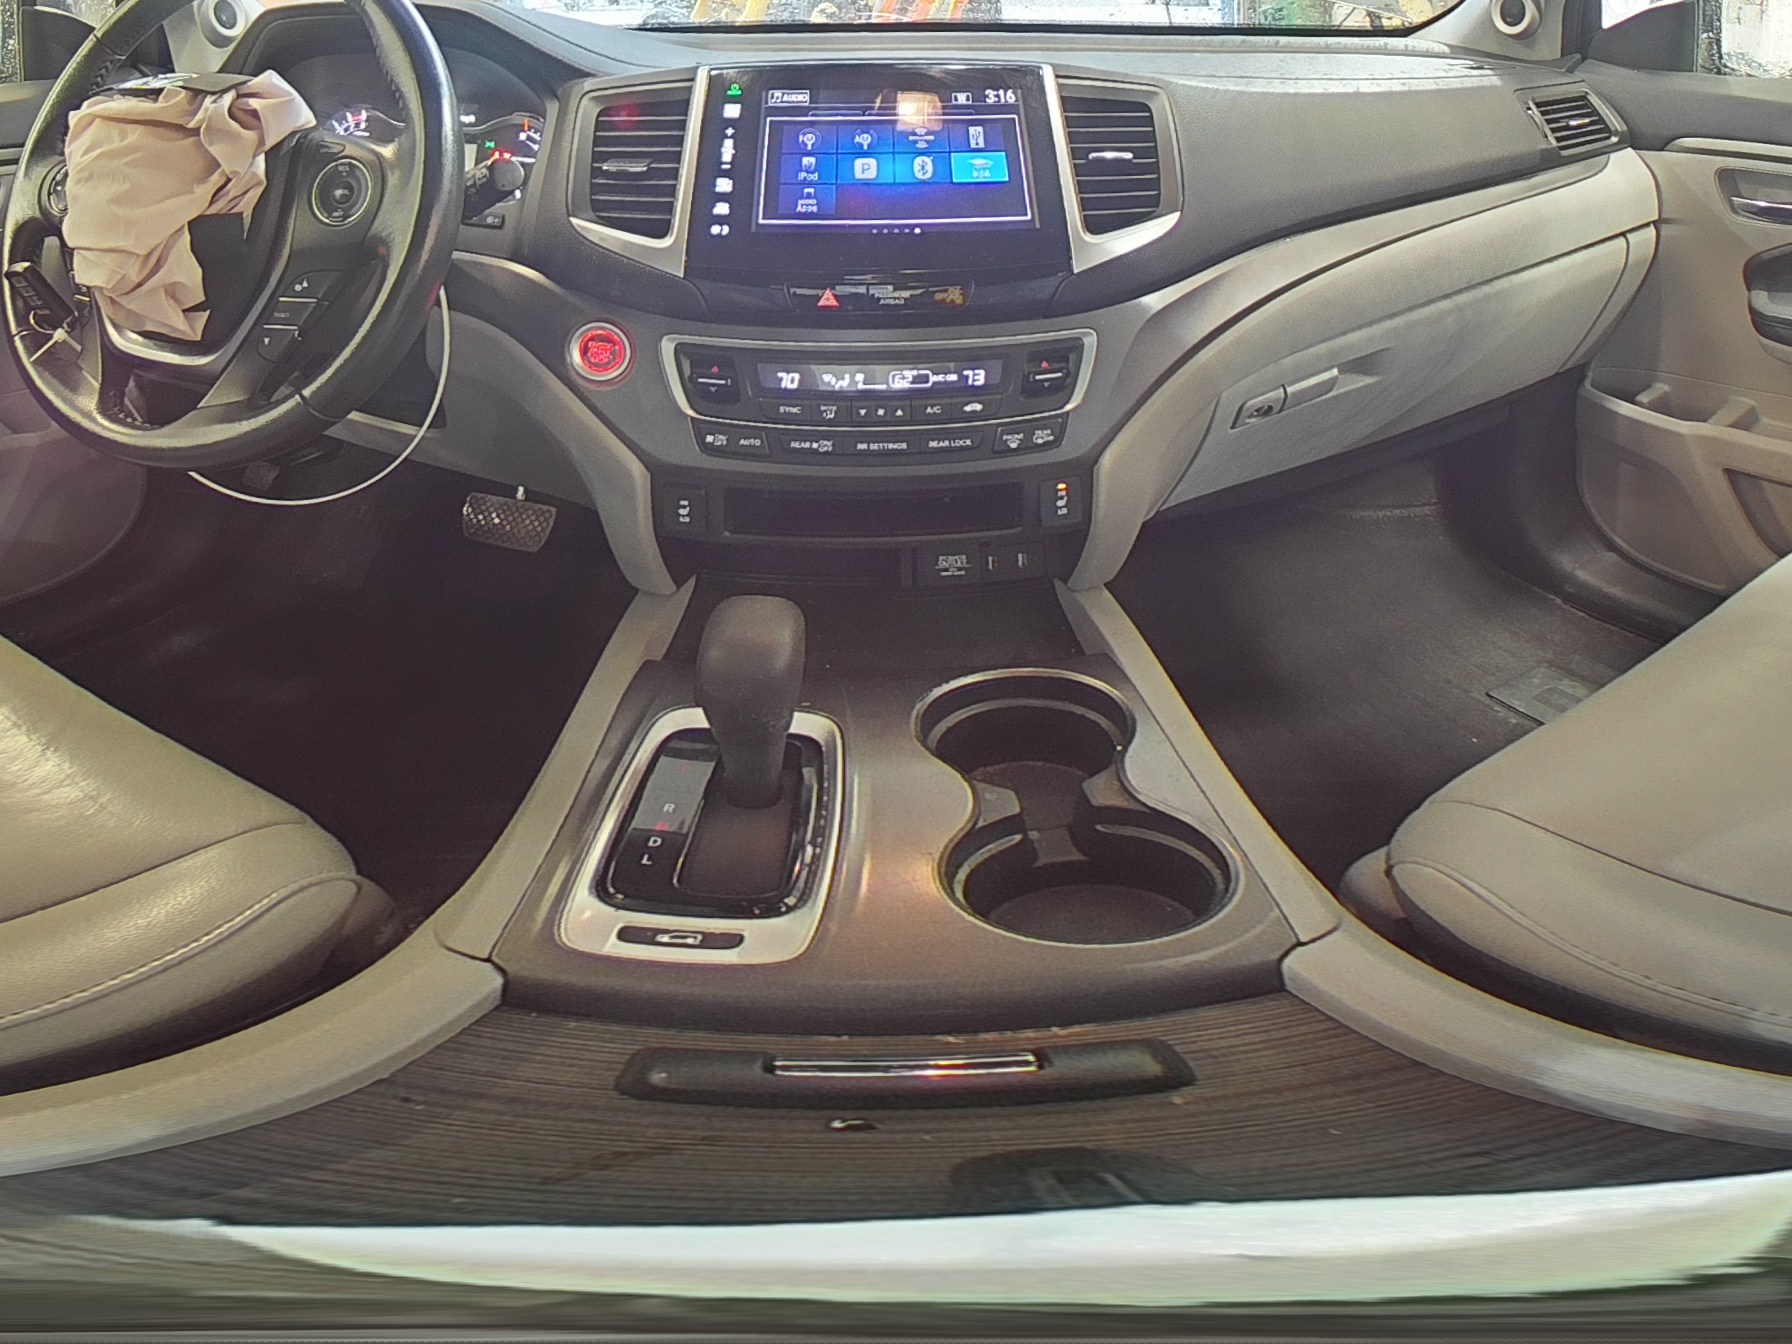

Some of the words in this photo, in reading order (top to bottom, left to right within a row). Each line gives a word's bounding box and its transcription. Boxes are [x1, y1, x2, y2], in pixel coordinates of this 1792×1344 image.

[782, 93, 808, 102] AUDIO
[984, 89, 1016, 103] 3:16
[776, 372, 801, 389] 70
[963, 369, 986, 386] 73
[779, 405, 802, 414] SYNC
[925, 405, 942, 414] A/C
[739, 438, 761, 446] AUTO
[790, 440, 811, 448] REAR
[928, 439, 950, 448] REAR
[950, 438, 972, 447] LOCK
[662, 803, 675, 813] R
[647, 836, 662, 847] D
[640, 854, 653, 865] L
